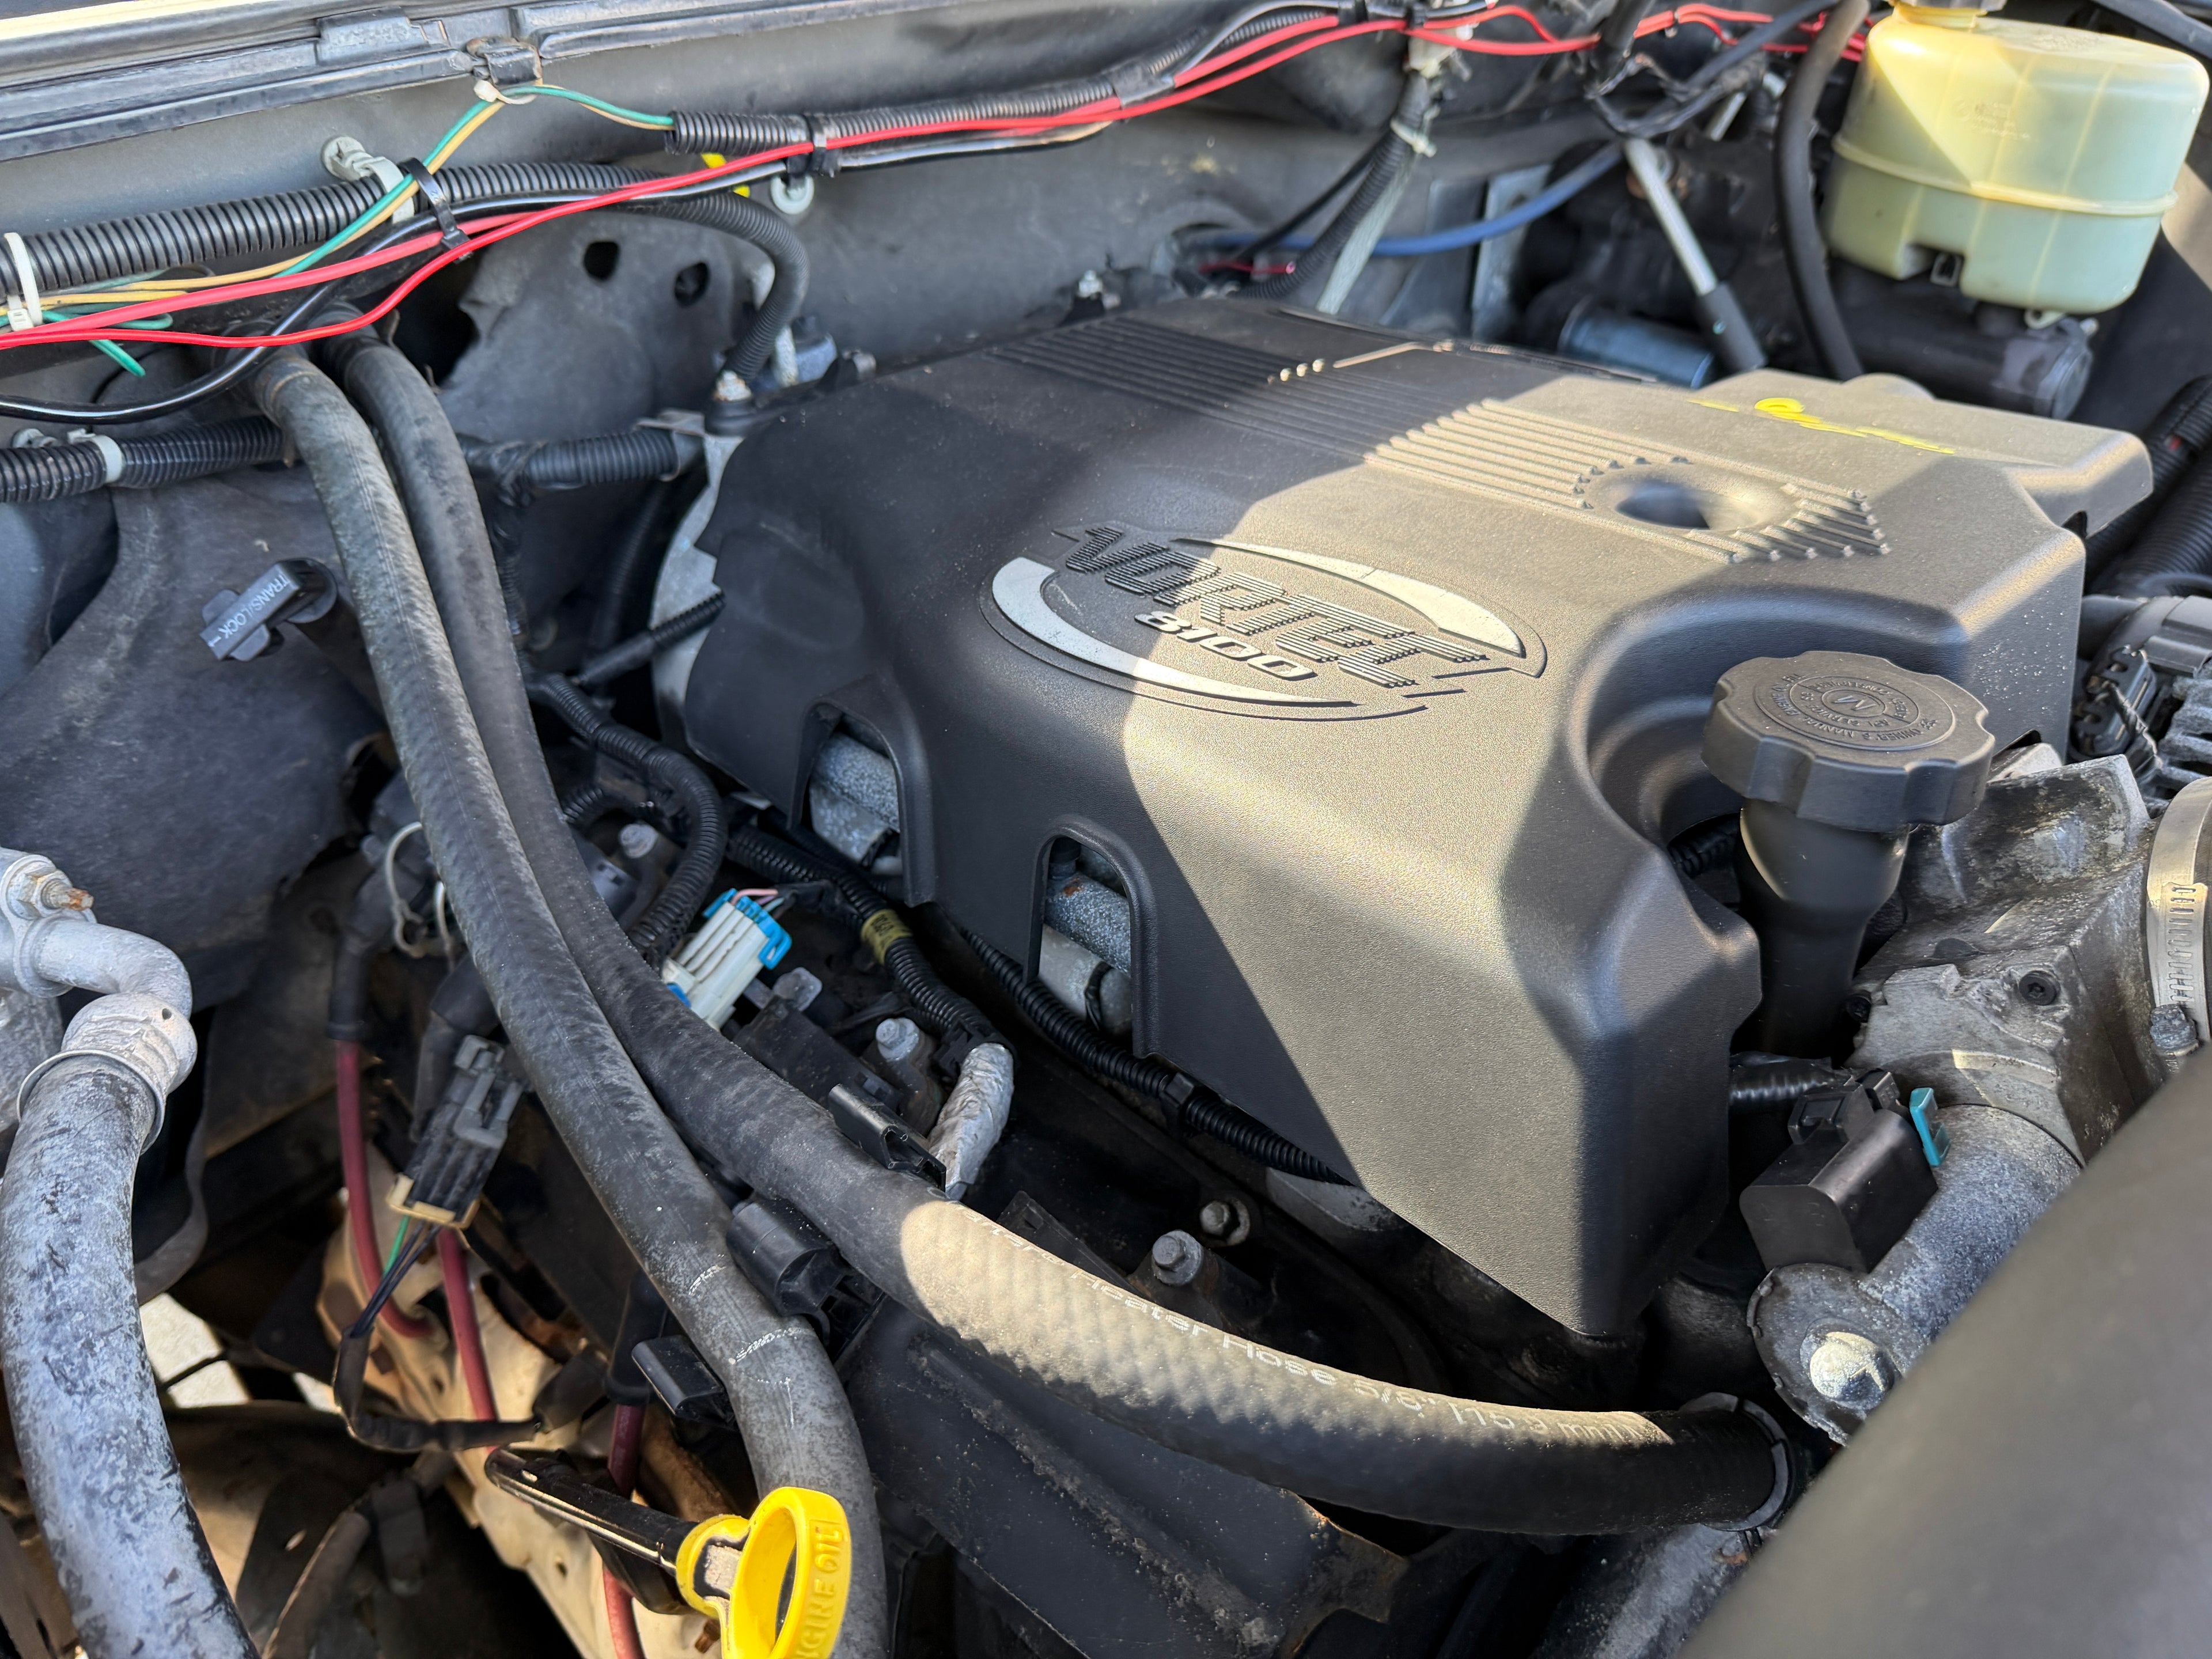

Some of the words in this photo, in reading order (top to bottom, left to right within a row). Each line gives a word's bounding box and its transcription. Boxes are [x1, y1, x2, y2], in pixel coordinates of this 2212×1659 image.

[218, 573, 291, 638] TRANS/LOCK
[1052, 525, 1488, 688] VORTEC
[1134, 613, 1317, 680] 8100
[1802, 717, 1854, 738] MANUAL
[1866, 718, 1896, 727] API
[1070, 1267, 1209, 1336] Heater
[1222, 1332, 1336, 1385] Hose
[813, 1528, 843, 1574] OIL
